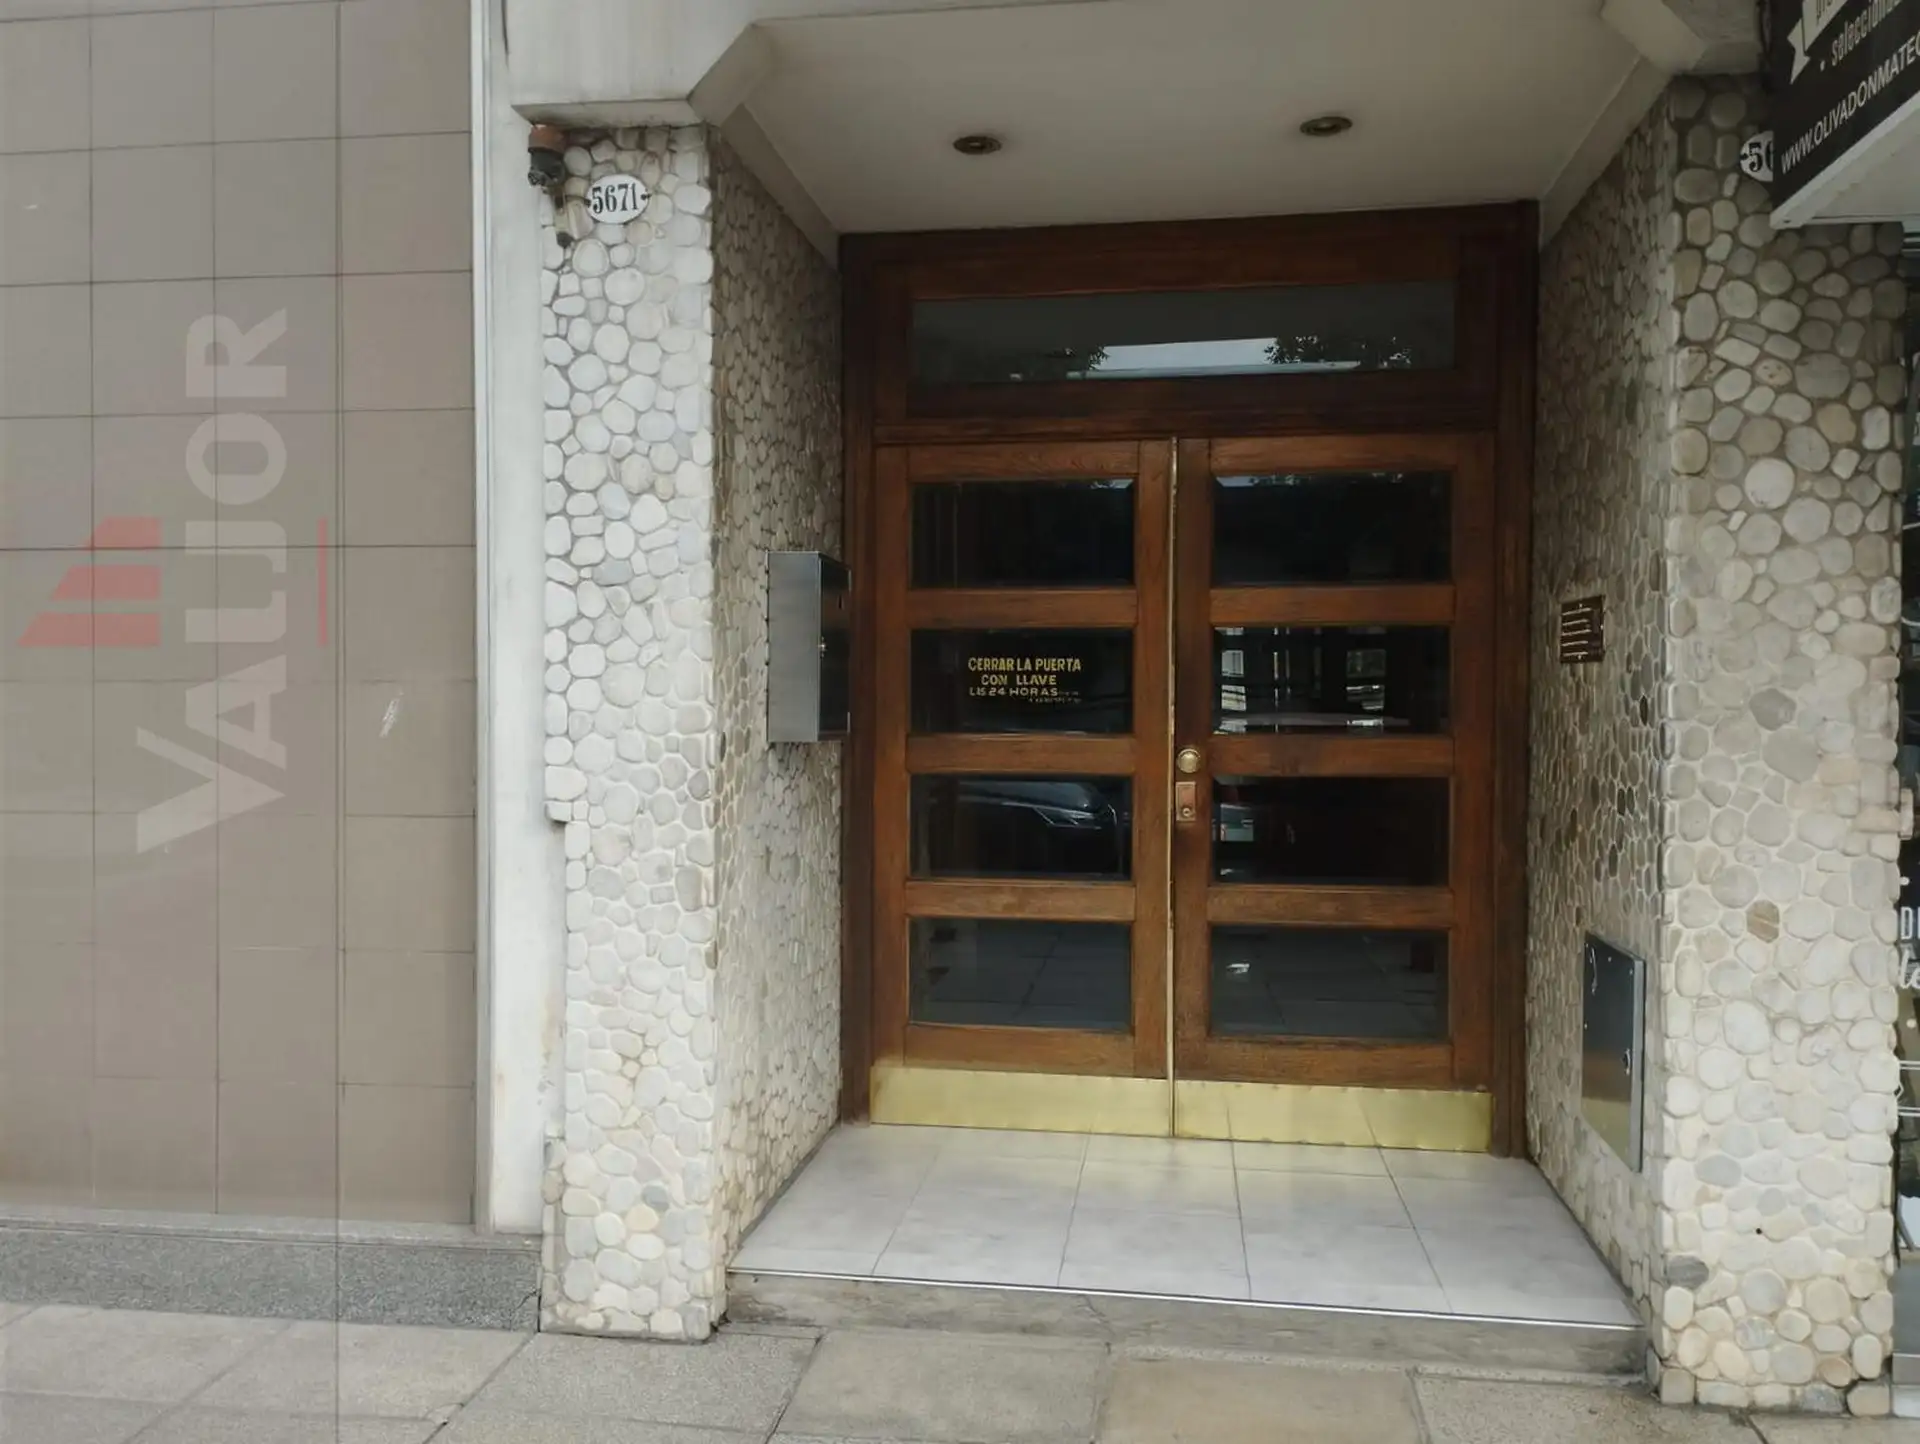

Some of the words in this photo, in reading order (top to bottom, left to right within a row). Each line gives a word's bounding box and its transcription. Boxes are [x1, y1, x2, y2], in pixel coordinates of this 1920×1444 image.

[592, 182, 638, 214] 5671
[968, 657, 1014, 671] CERRAR
[1017, 658, 1032, 671] LA
[1035, 658, 1081, 672] PUERTA
[981, 674, 1007, 685] CON
[1016, 674, 1056, 685] LLAVE
[988, 687, 1006, 696] 24
[1009, 687, 1058, 697] HORAS
